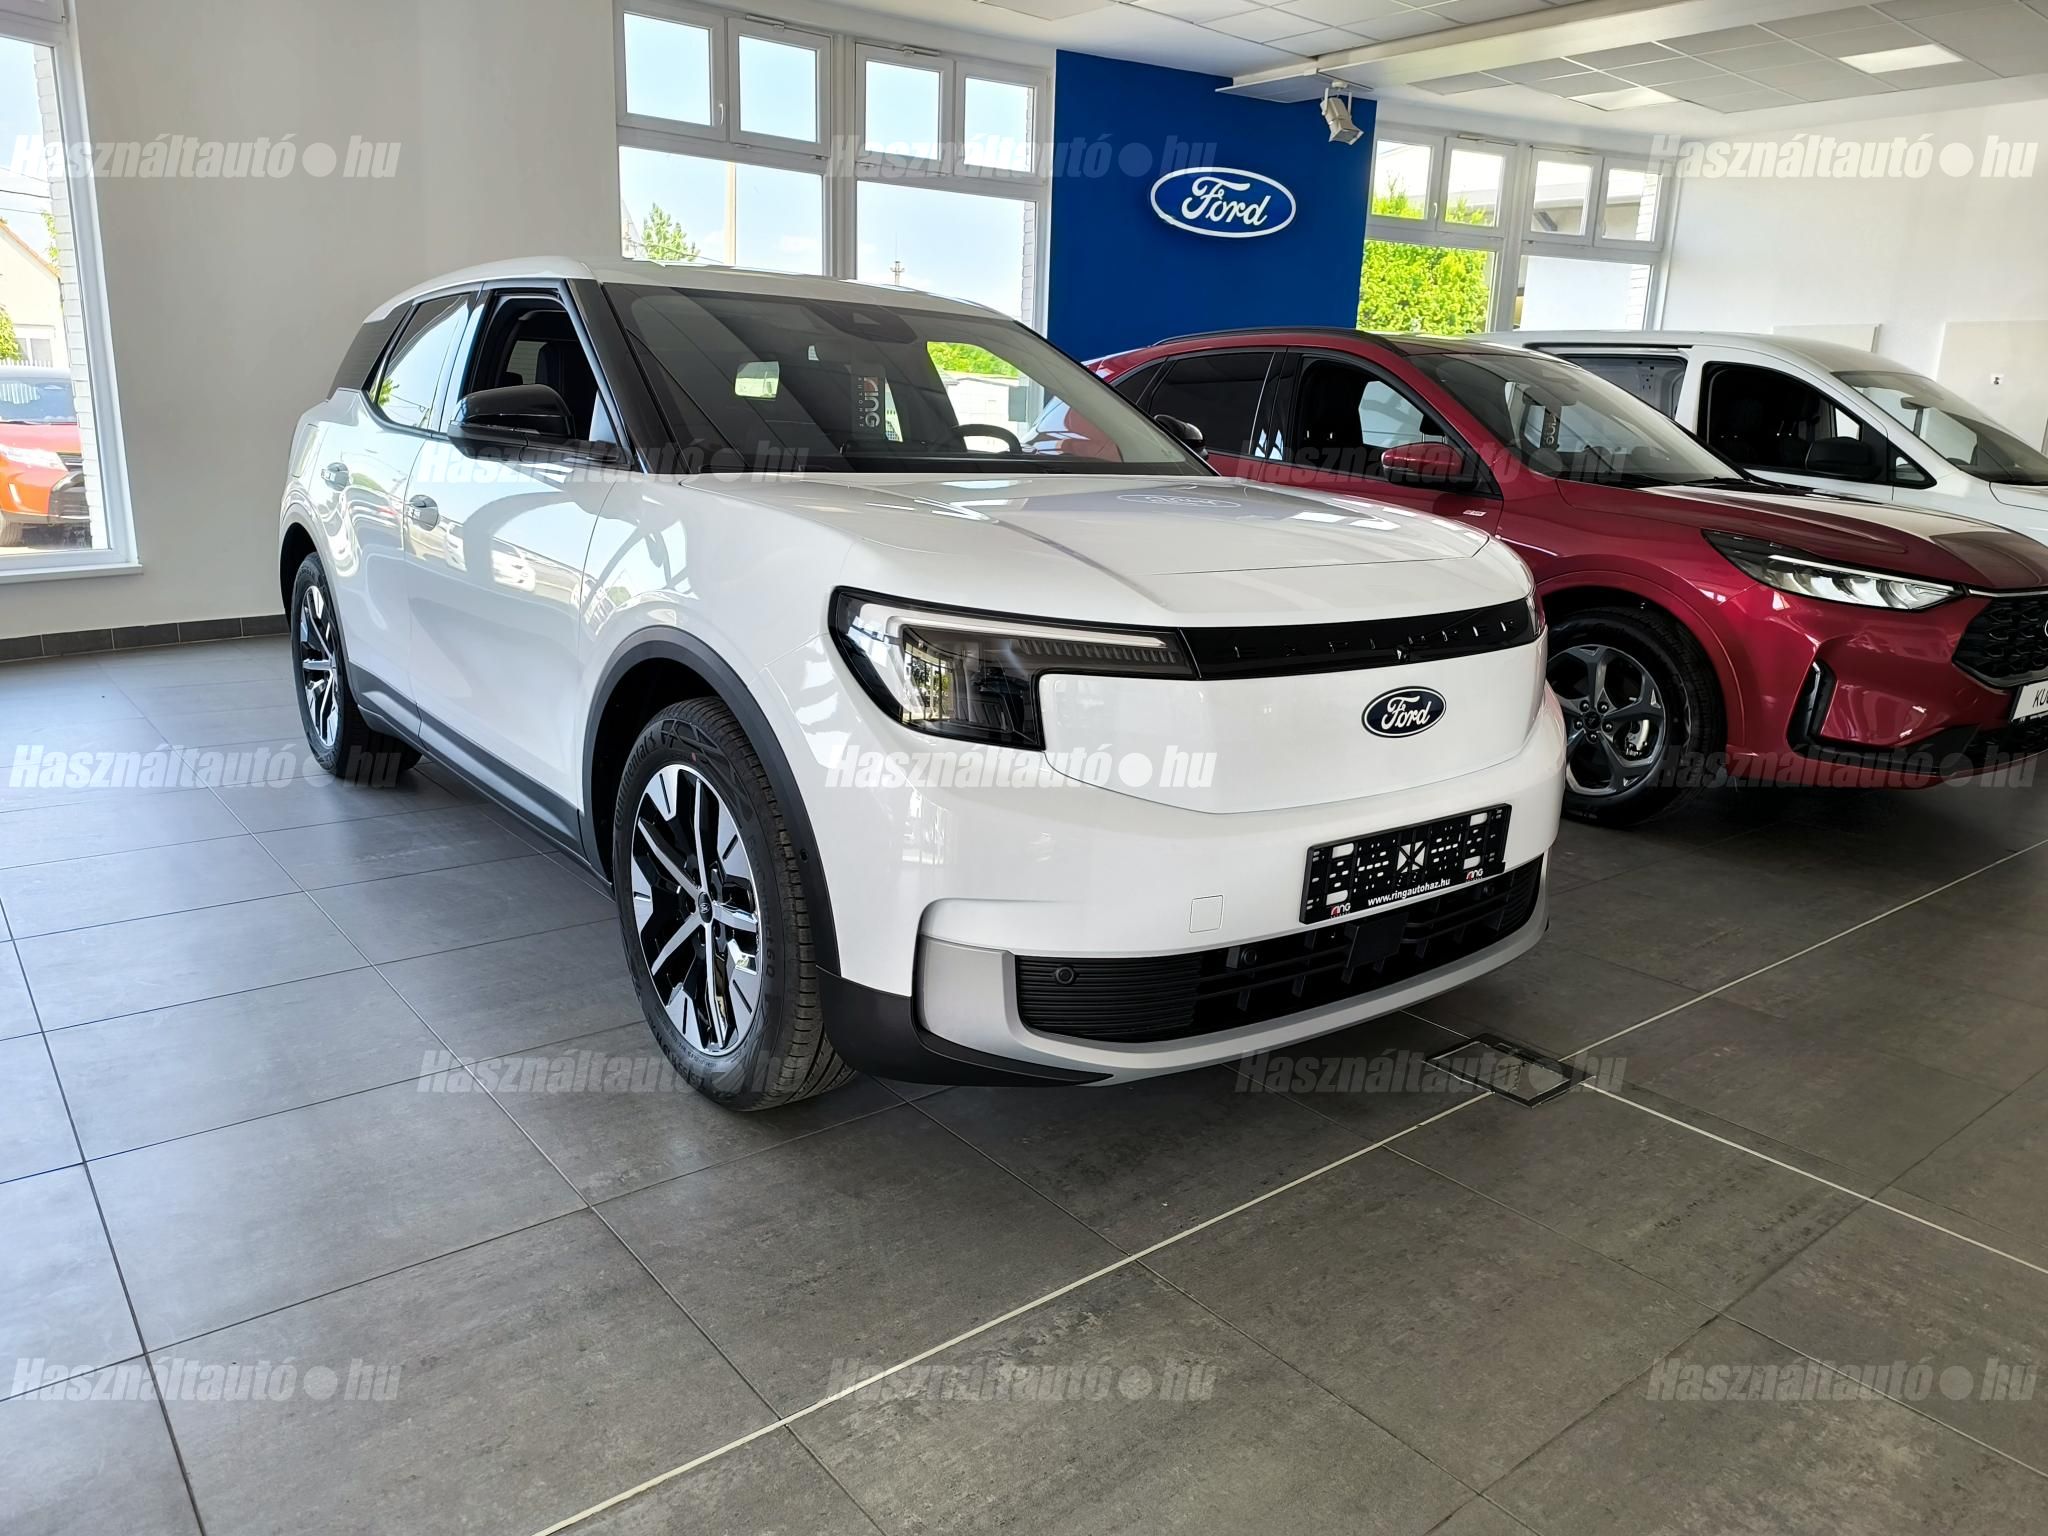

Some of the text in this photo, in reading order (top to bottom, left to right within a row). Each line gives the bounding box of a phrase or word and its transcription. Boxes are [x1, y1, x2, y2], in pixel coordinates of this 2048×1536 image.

[1181, 176, 1272, 226] Ford
[1381, 695, 1432, 730] Ford
[1367, 877, 1451, 906] www.ringautohaz.hu
